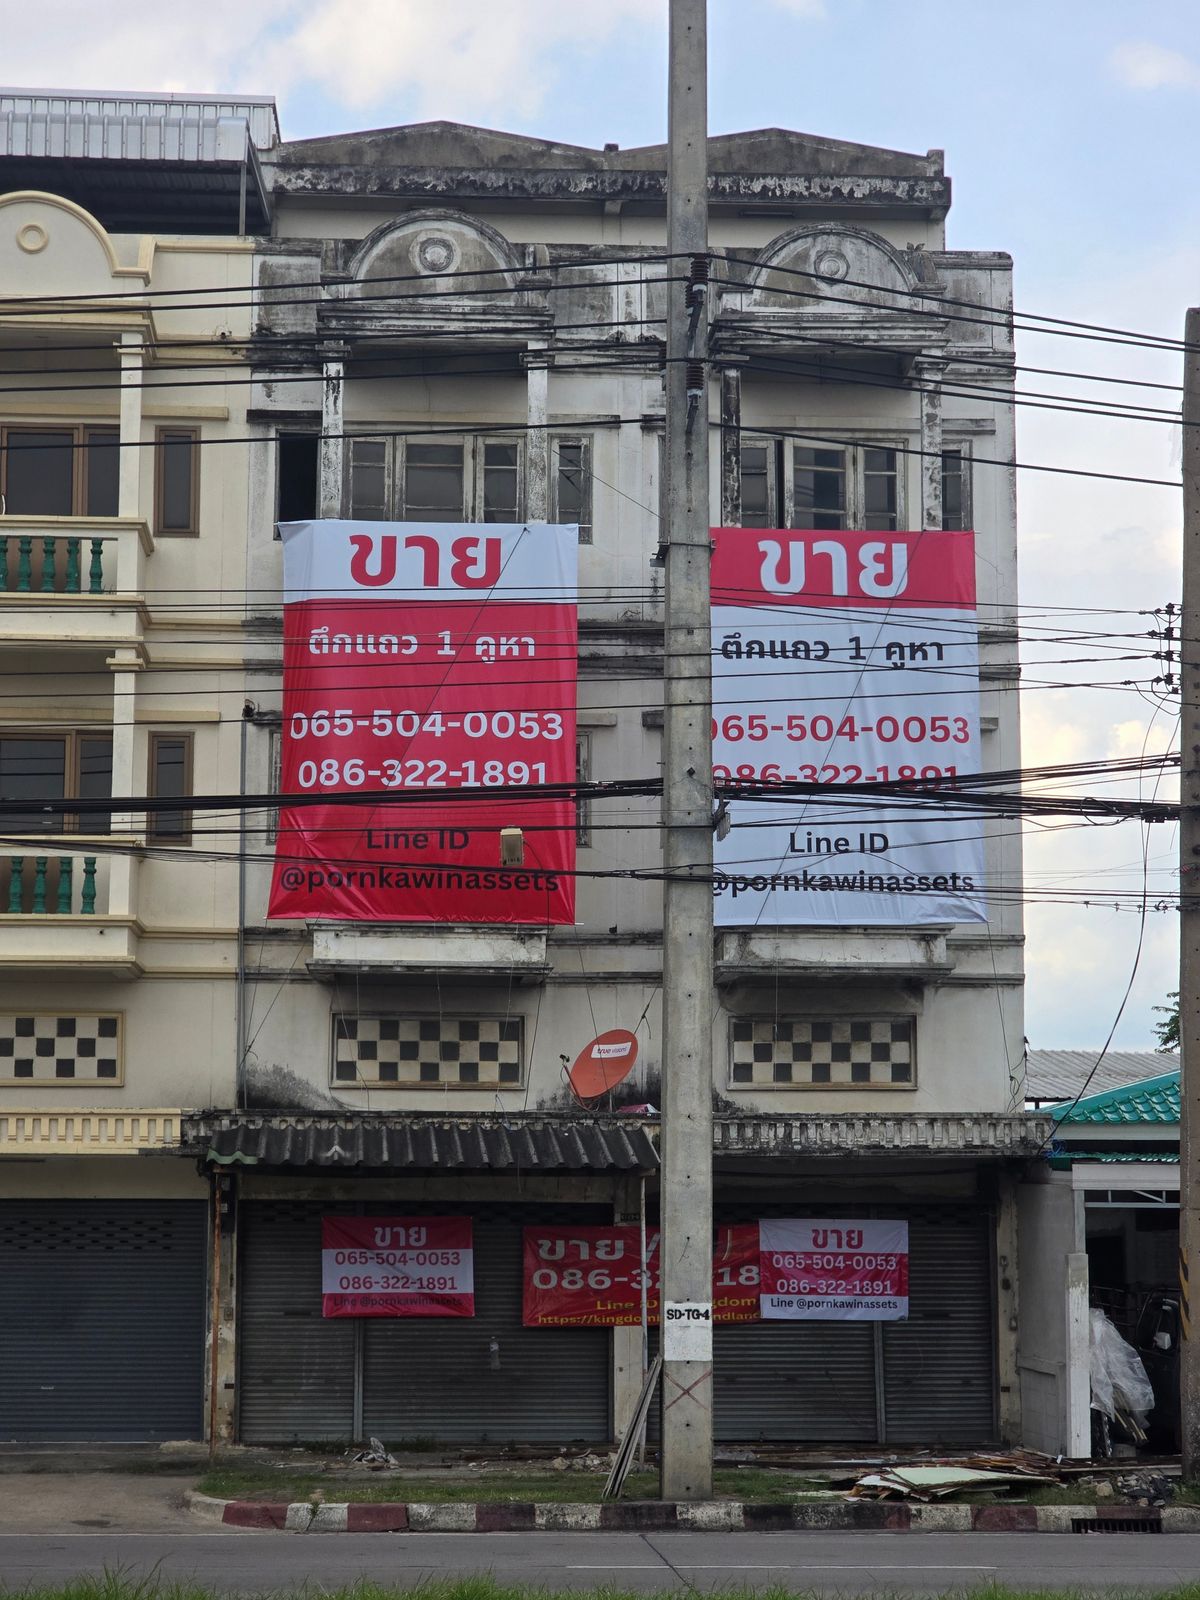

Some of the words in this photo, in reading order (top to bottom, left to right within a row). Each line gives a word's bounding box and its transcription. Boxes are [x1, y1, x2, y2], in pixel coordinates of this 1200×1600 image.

[349, 534, 502, 588] ขาย
[757, 540, 908, 598] ขาย
[309, 626, 418, 656] ตึกแถว
[437, 630, 456, 656] 1
[475, 634, 536, 664] คูหา
[722, 632, 830, 661] ตึกแถว
[848, 636, 867, 661] 1
[885, 637, 944, 670] คูหา
[290, 709, 563, 740] 065-504-0053
[711, 714, 970, 744] 65-504-0053
[298, 759, 547, 788] 086-322-1891
[366, 828, 429, 850] Line
[439, 828, 470, 850] ID
[790, 832, 850, 854] Line
[860, 832, 889, 854] ID
[280, 865, 559, 893] @pornkawinassets
[373, 1225, 427, 1247] ขาย
[812, 1228, 863, 1250] ขาย
[335, 1251, 461, 1266] 065-504-0053
[537, 1238, 625, 1260] ขาย
[772, 1254, 897, 1271] 065-504-0053
[339, 1276, 458, 1290] 086-322-1891
[776, 1279, 893, 1295] 086-322-1891
[596, 1300, 635, 1310] Line
[771, 1297, 794, 1309] Line
[796, 1299, 899, 1311] @pornkawinassets
